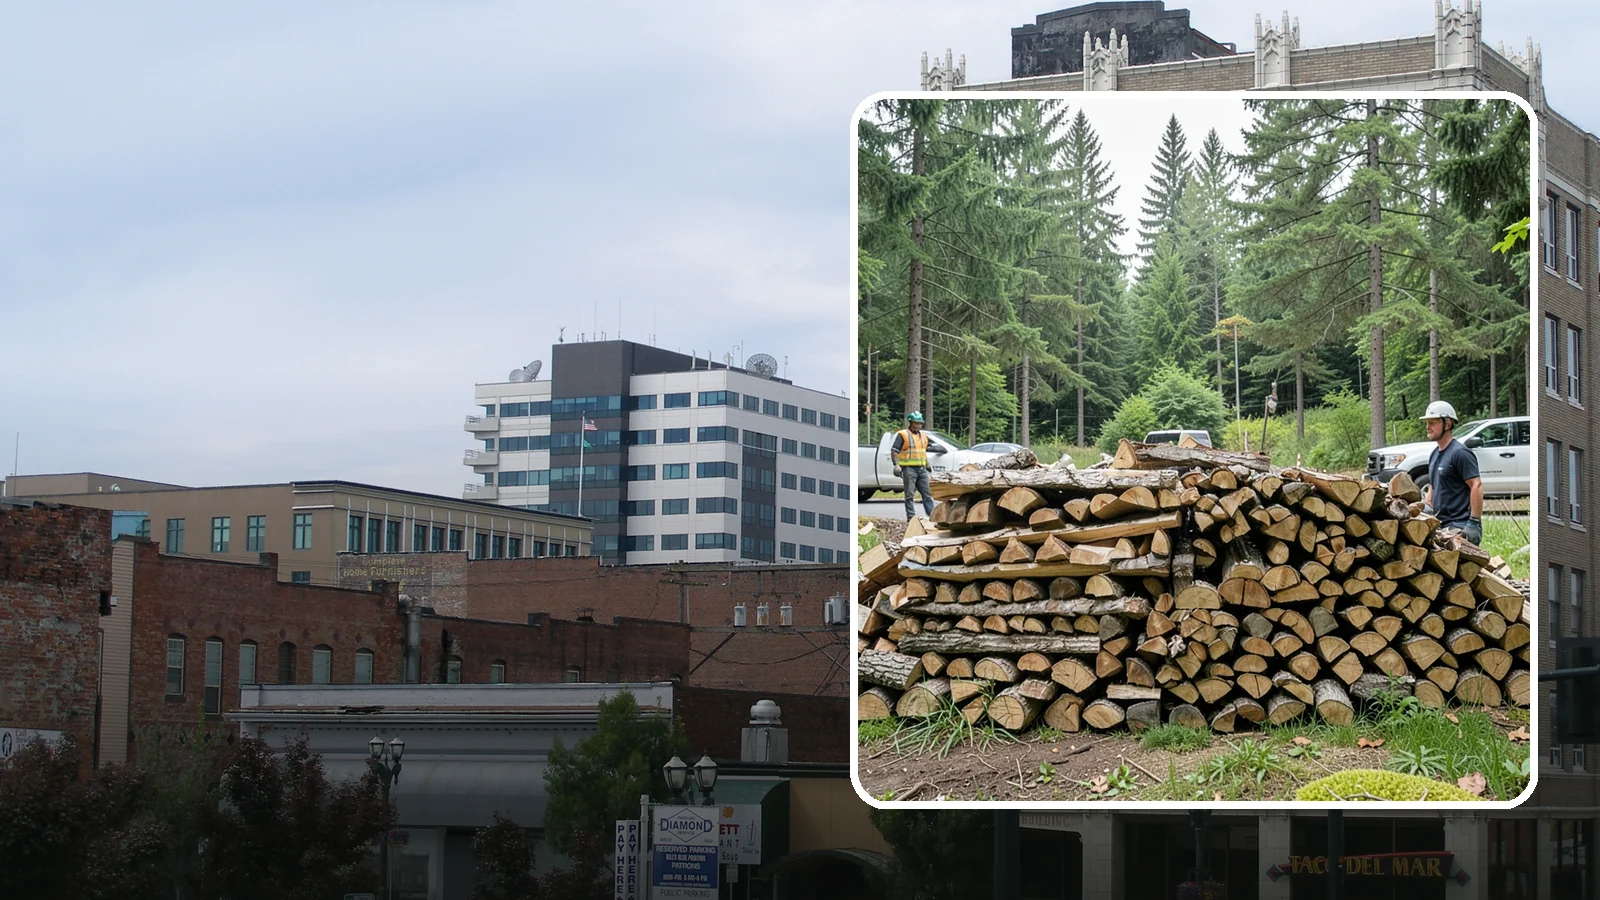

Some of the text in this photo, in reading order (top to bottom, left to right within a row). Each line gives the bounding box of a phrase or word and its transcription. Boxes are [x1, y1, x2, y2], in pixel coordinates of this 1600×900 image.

[343, 566, 427, 577] Home Furnishers
[660, 818, 713, 832] DIAMOND
[1021, 815, 1070, 828] BUILDING
[719, 824, 740, 835] ETT
[656, 845, 716, 854] RESERVED PARKING
[628, 825, 636, 893] PAY HERE
[671, 862, 701, 870] PATRONS
[1346, 856, 1385, 876] DEL
[1392, 857, 1442, 877] MAR
[617, 856, 625, 893] HERE
[660, 888, 710, 898] PUBLIC PARKING
